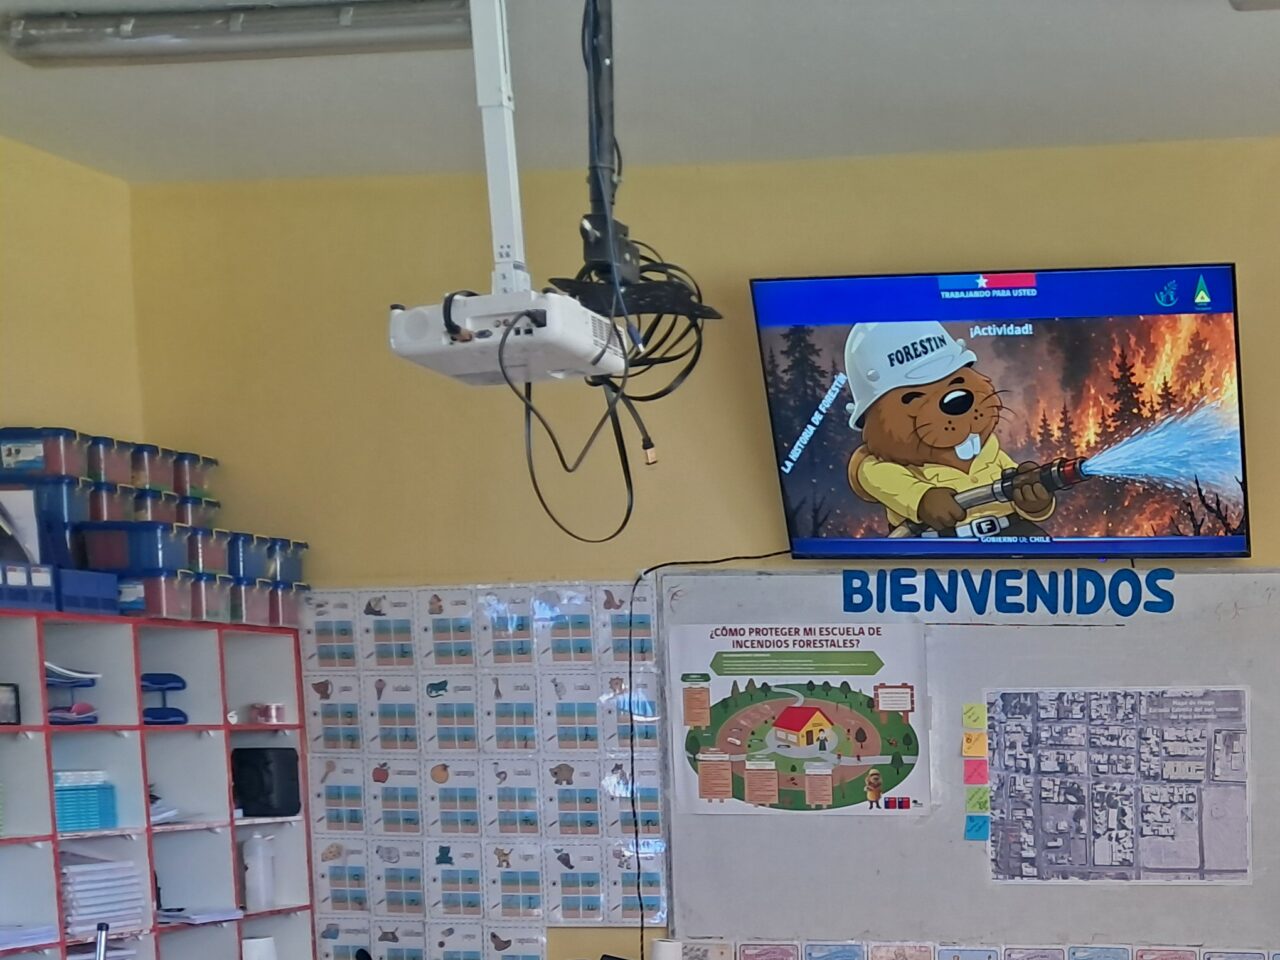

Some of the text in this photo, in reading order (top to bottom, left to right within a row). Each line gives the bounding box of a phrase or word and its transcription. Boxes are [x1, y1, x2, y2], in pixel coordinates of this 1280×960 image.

[941, 288, 1037, 299] TRABAJANDO PARA USTED
[969, 323, 1034, 338] ¡Actividad!
[887, 335, 947, 367] FORESTIN
[781, 460, 794, 474] LA
[788, 424, 816, 461] HISTORIA
[811, 410, 824, 426] DE
[980, 521, 992, 533] F
[842, 567, 1175, 617] BIENVENIDOS
[710, 626, 882, 640] ¿CÓMO PROTEGER MI ESCUELA DE
[732, 639, 860, 649] INCENDIOS FORESTALES?
